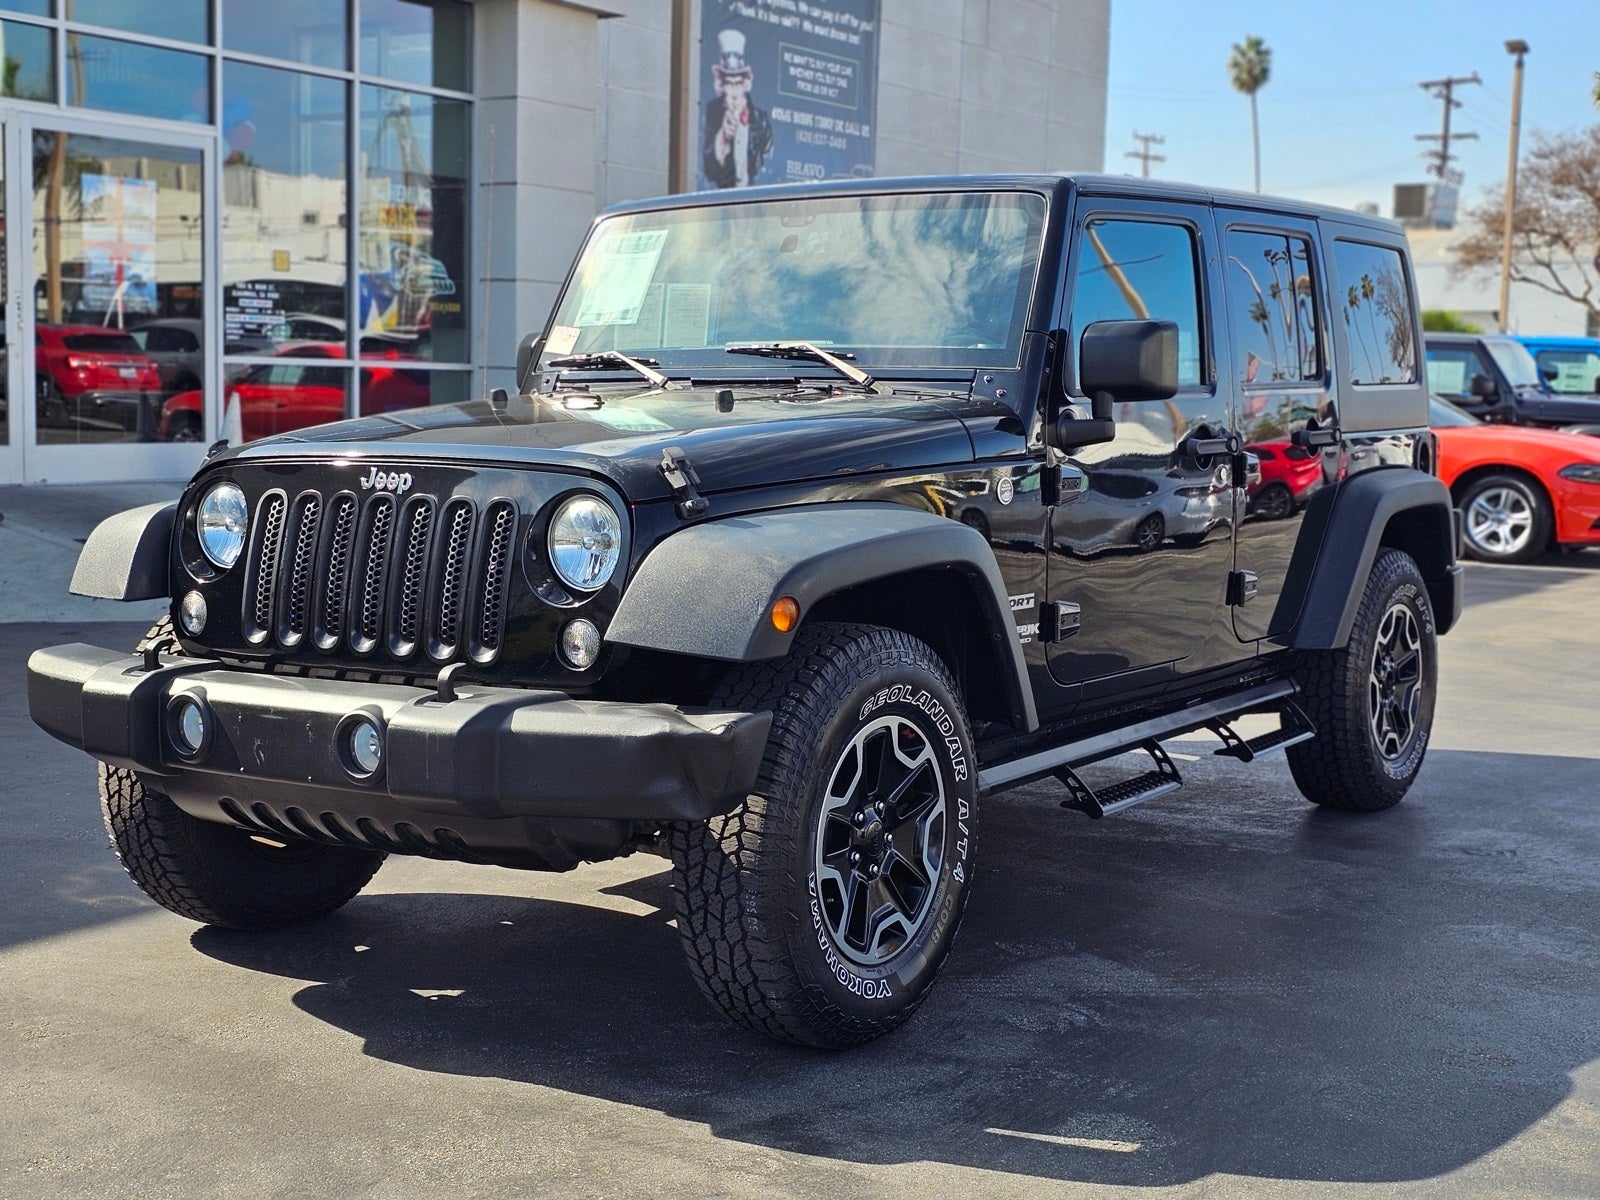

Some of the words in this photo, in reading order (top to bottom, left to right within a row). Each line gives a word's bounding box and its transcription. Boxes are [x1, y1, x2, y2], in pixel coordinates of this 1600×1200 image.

[786, 160, 825, 179] BRAVO
[360, 467, 413, 495] Jeep
[1009, 596, 1035, 608] ORT
[858, 684, 968, 783] GEOLANDAR
[808, 871, 892, 1000] YOKOHAMA
